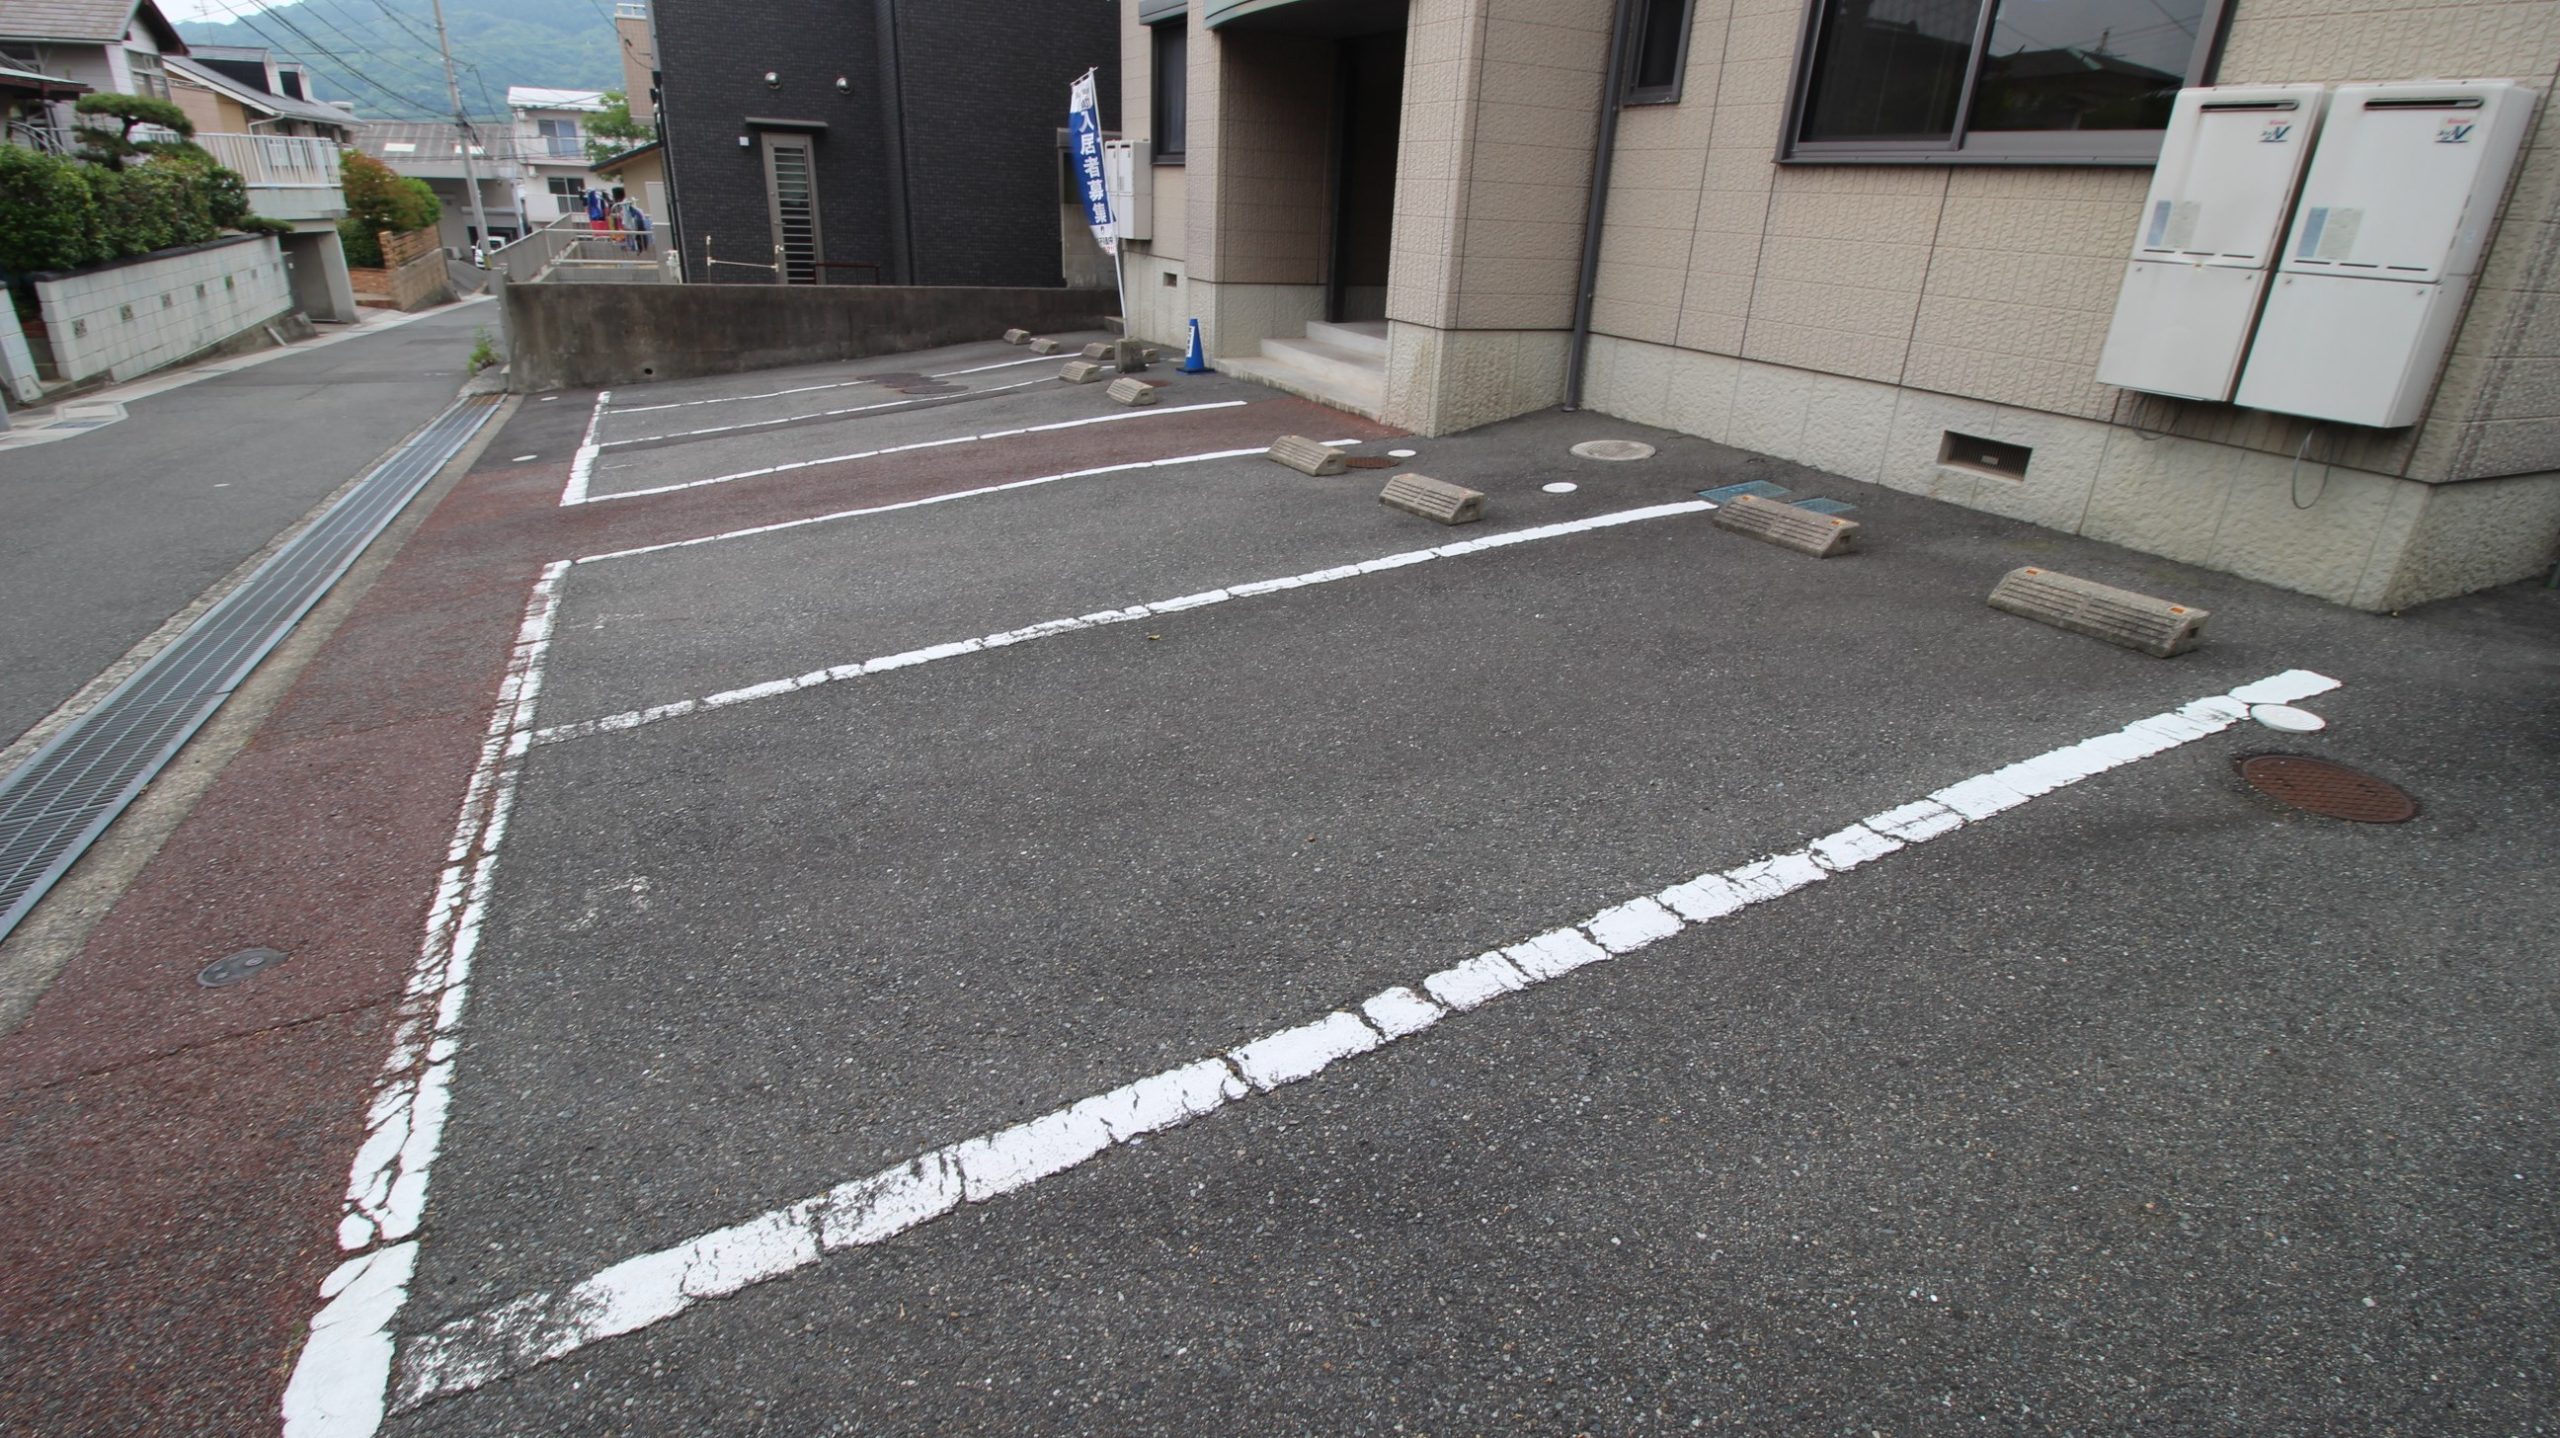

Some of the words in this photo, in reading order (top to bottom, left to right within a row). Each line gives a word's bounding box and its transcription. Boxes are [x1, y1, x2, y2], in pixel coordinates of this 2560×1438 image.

[1079, 111, 1108, 223] 入居者募集
